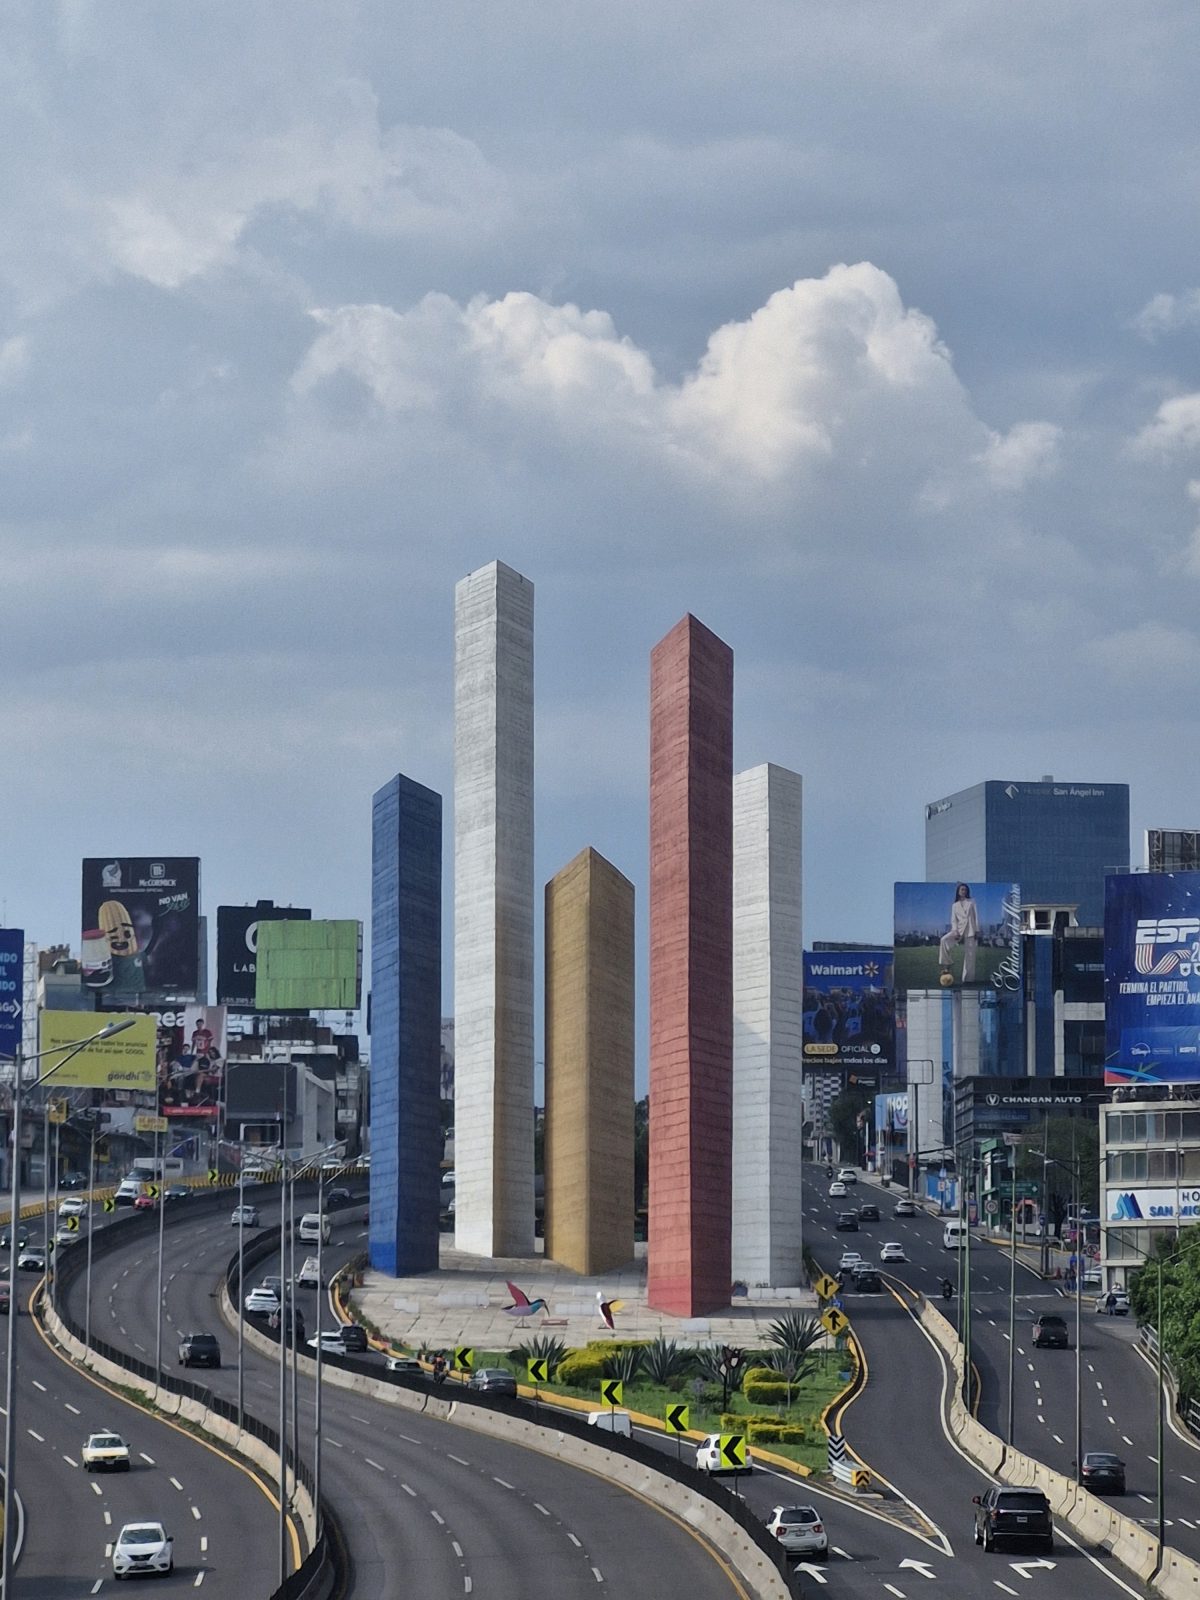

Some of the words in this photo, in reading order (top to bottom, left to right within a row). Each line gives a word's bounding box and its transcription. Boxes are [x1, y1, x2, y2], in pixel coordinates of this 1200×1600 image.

[1053, 787, 1068, 796] San
[1070, 786, 1091, 798] Ángel
[1092, 788, 1105, 796] Inn
[159, 897, 171, 906] NO
[171, 892, 188, 902] VAN
[1135, 918, 1200, 944] ESP
[810, 965, 863, 975] Walmart
[0, 981, 16, 991] DO
[1120, 982, 1148, 994] TERMINA
[1150, 982, 1157, 993] EL
[1146, 994, 1176, 1006] EMPIEZA
[1177, 993, 1184, 1005] EL
[0, 1002, 15, 1013] Go
[1149, 1206, 1174, 1217] SAN
